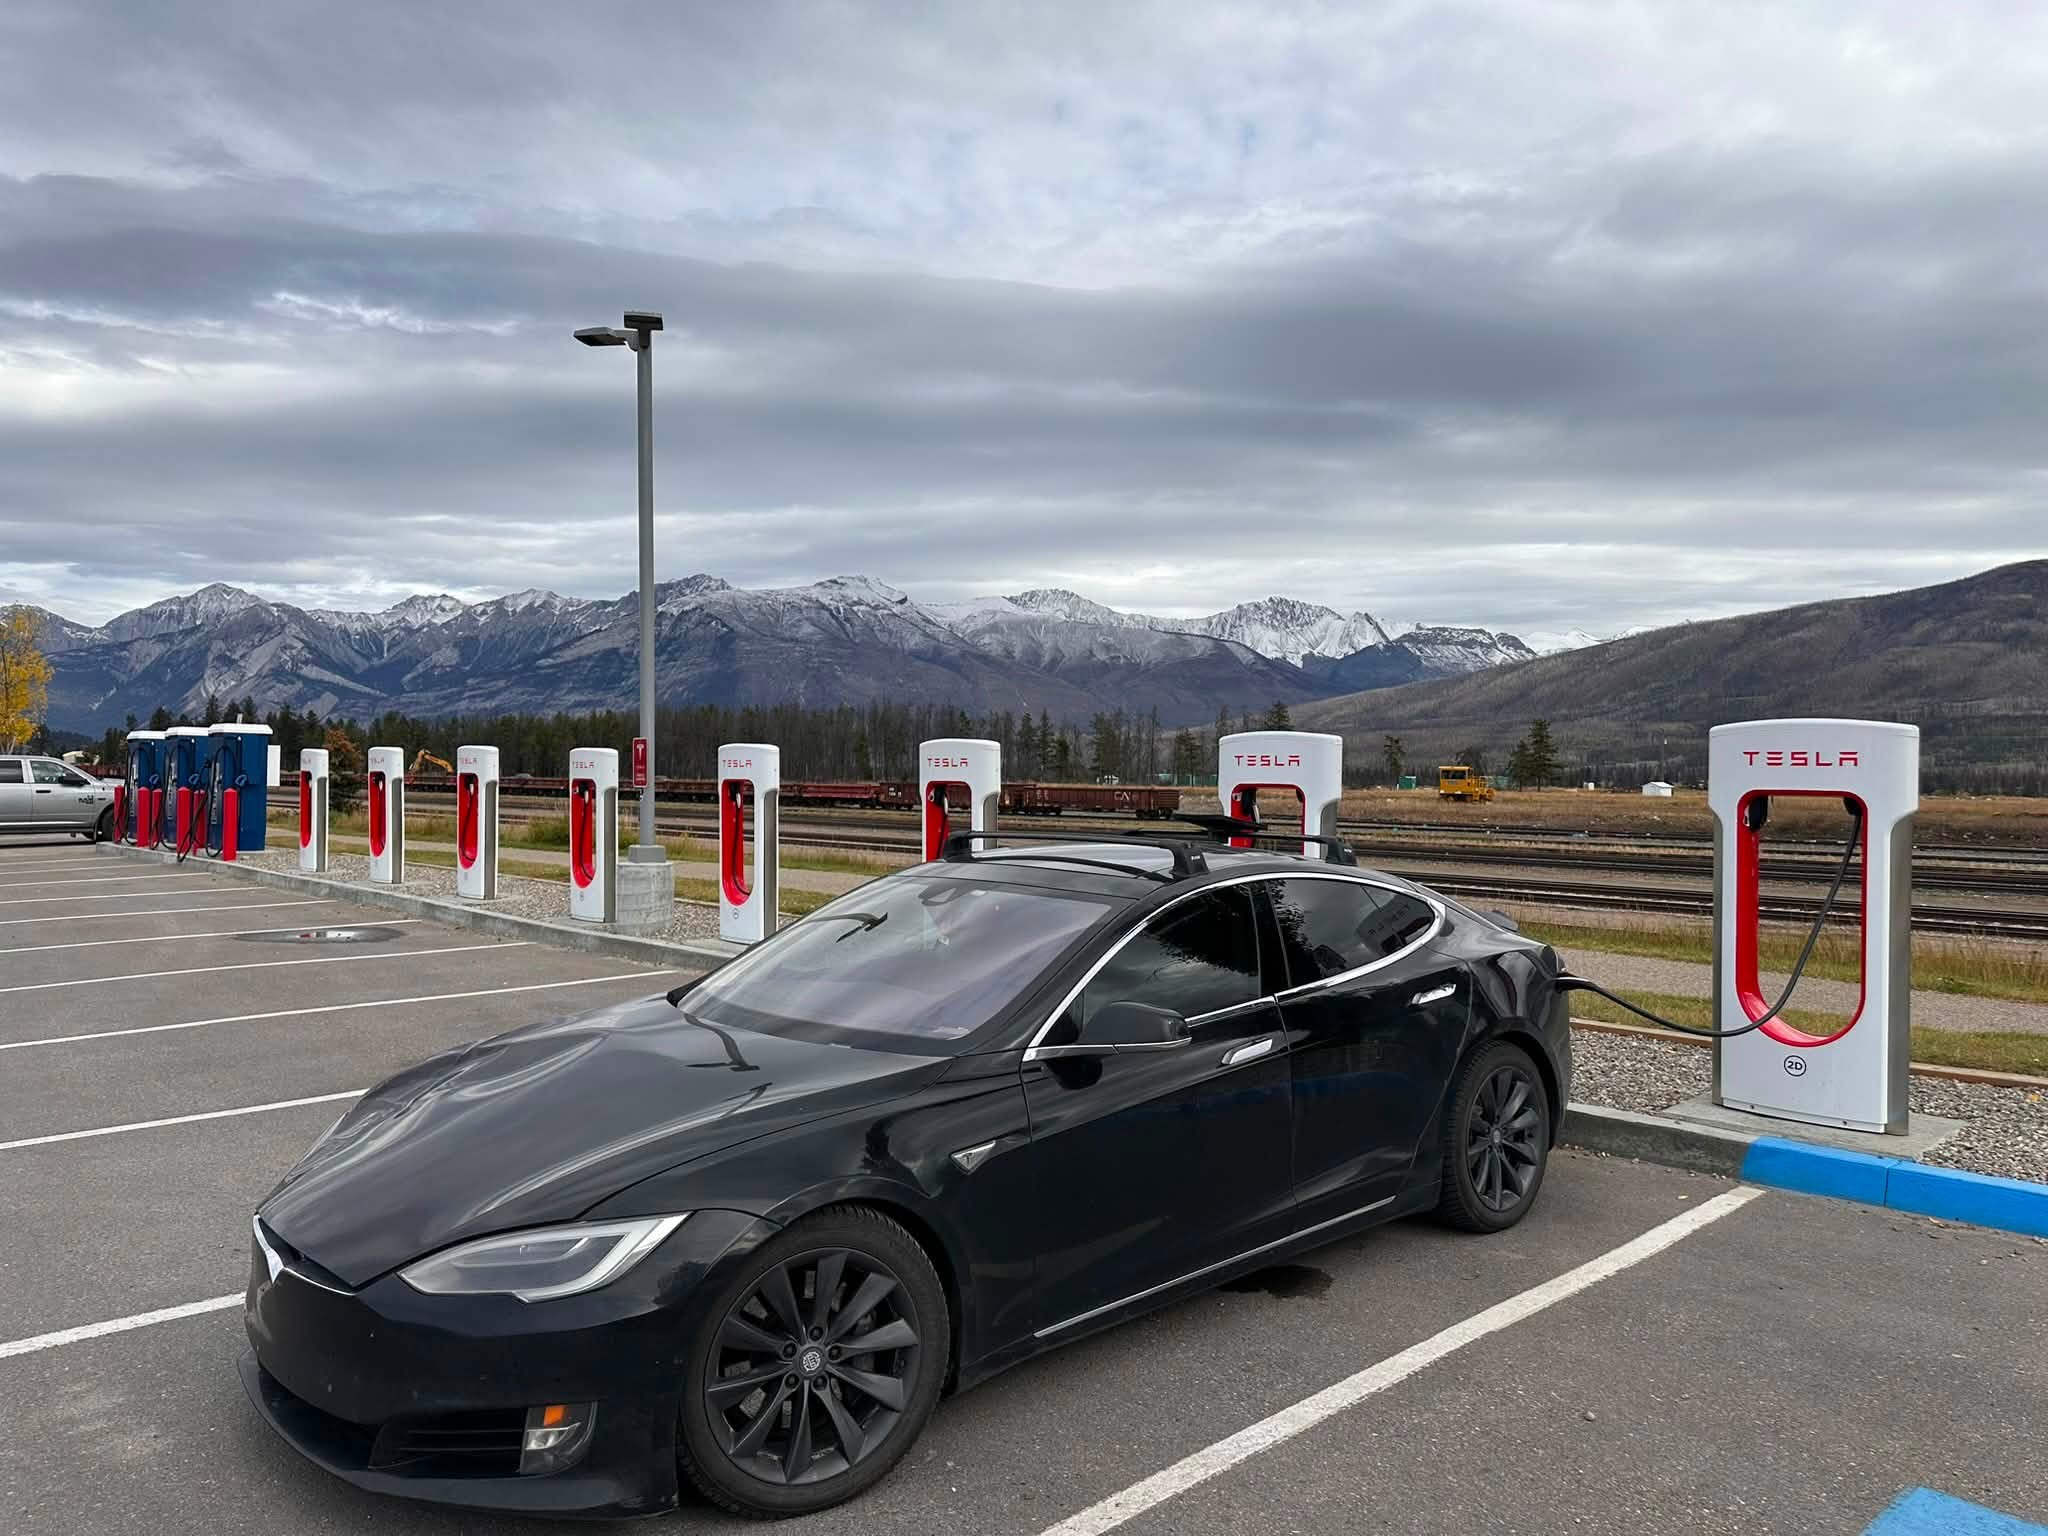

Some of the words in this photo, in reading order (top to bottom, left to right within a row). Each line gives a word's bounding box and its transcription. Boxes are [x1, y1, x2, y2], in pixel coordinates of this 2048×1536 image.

[722, 760, 752, 768] TESLA
[927, 758, 969, 768] TESLA
[1234, 755, 1301, 767] TESLA
[1742, 751, 1859, 767] TESLA
[1787, 1060, 1803, 1071] 2D
